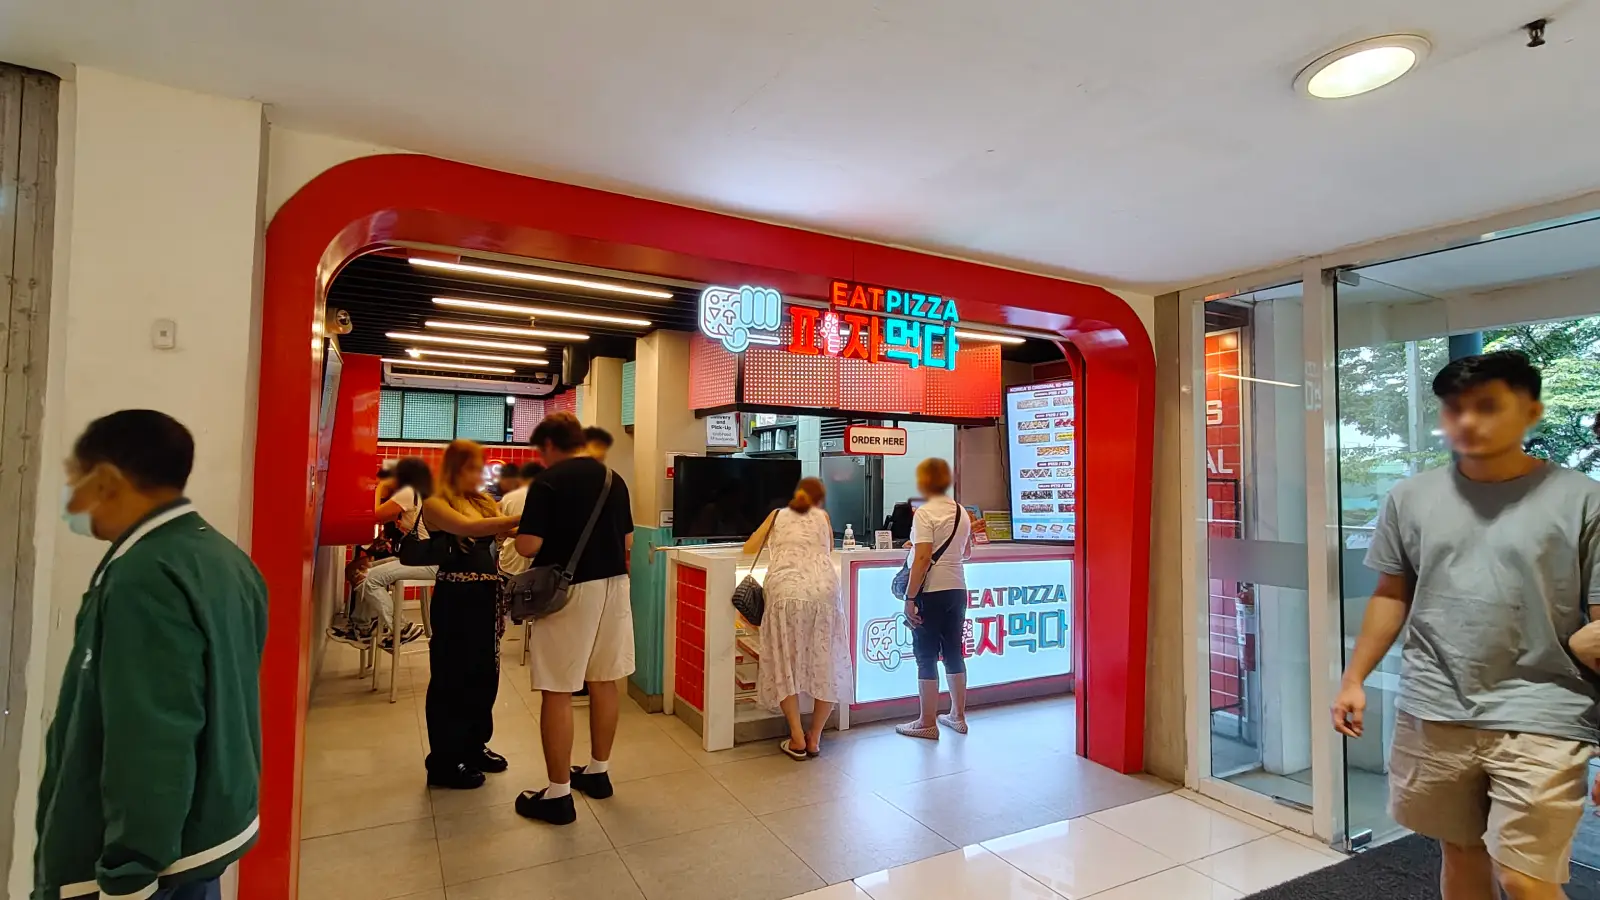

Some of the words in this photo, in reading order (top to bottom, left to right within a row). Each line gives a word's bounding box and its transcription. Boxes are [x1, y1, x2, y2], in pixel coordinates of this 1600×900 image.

[833, 281, 960, 323] EATPIZZA
[851, 435, 881, 446] ORDER
[882, 437, 905, 446] HERE
[967, 584, 1067, 609] EATPIZZA
